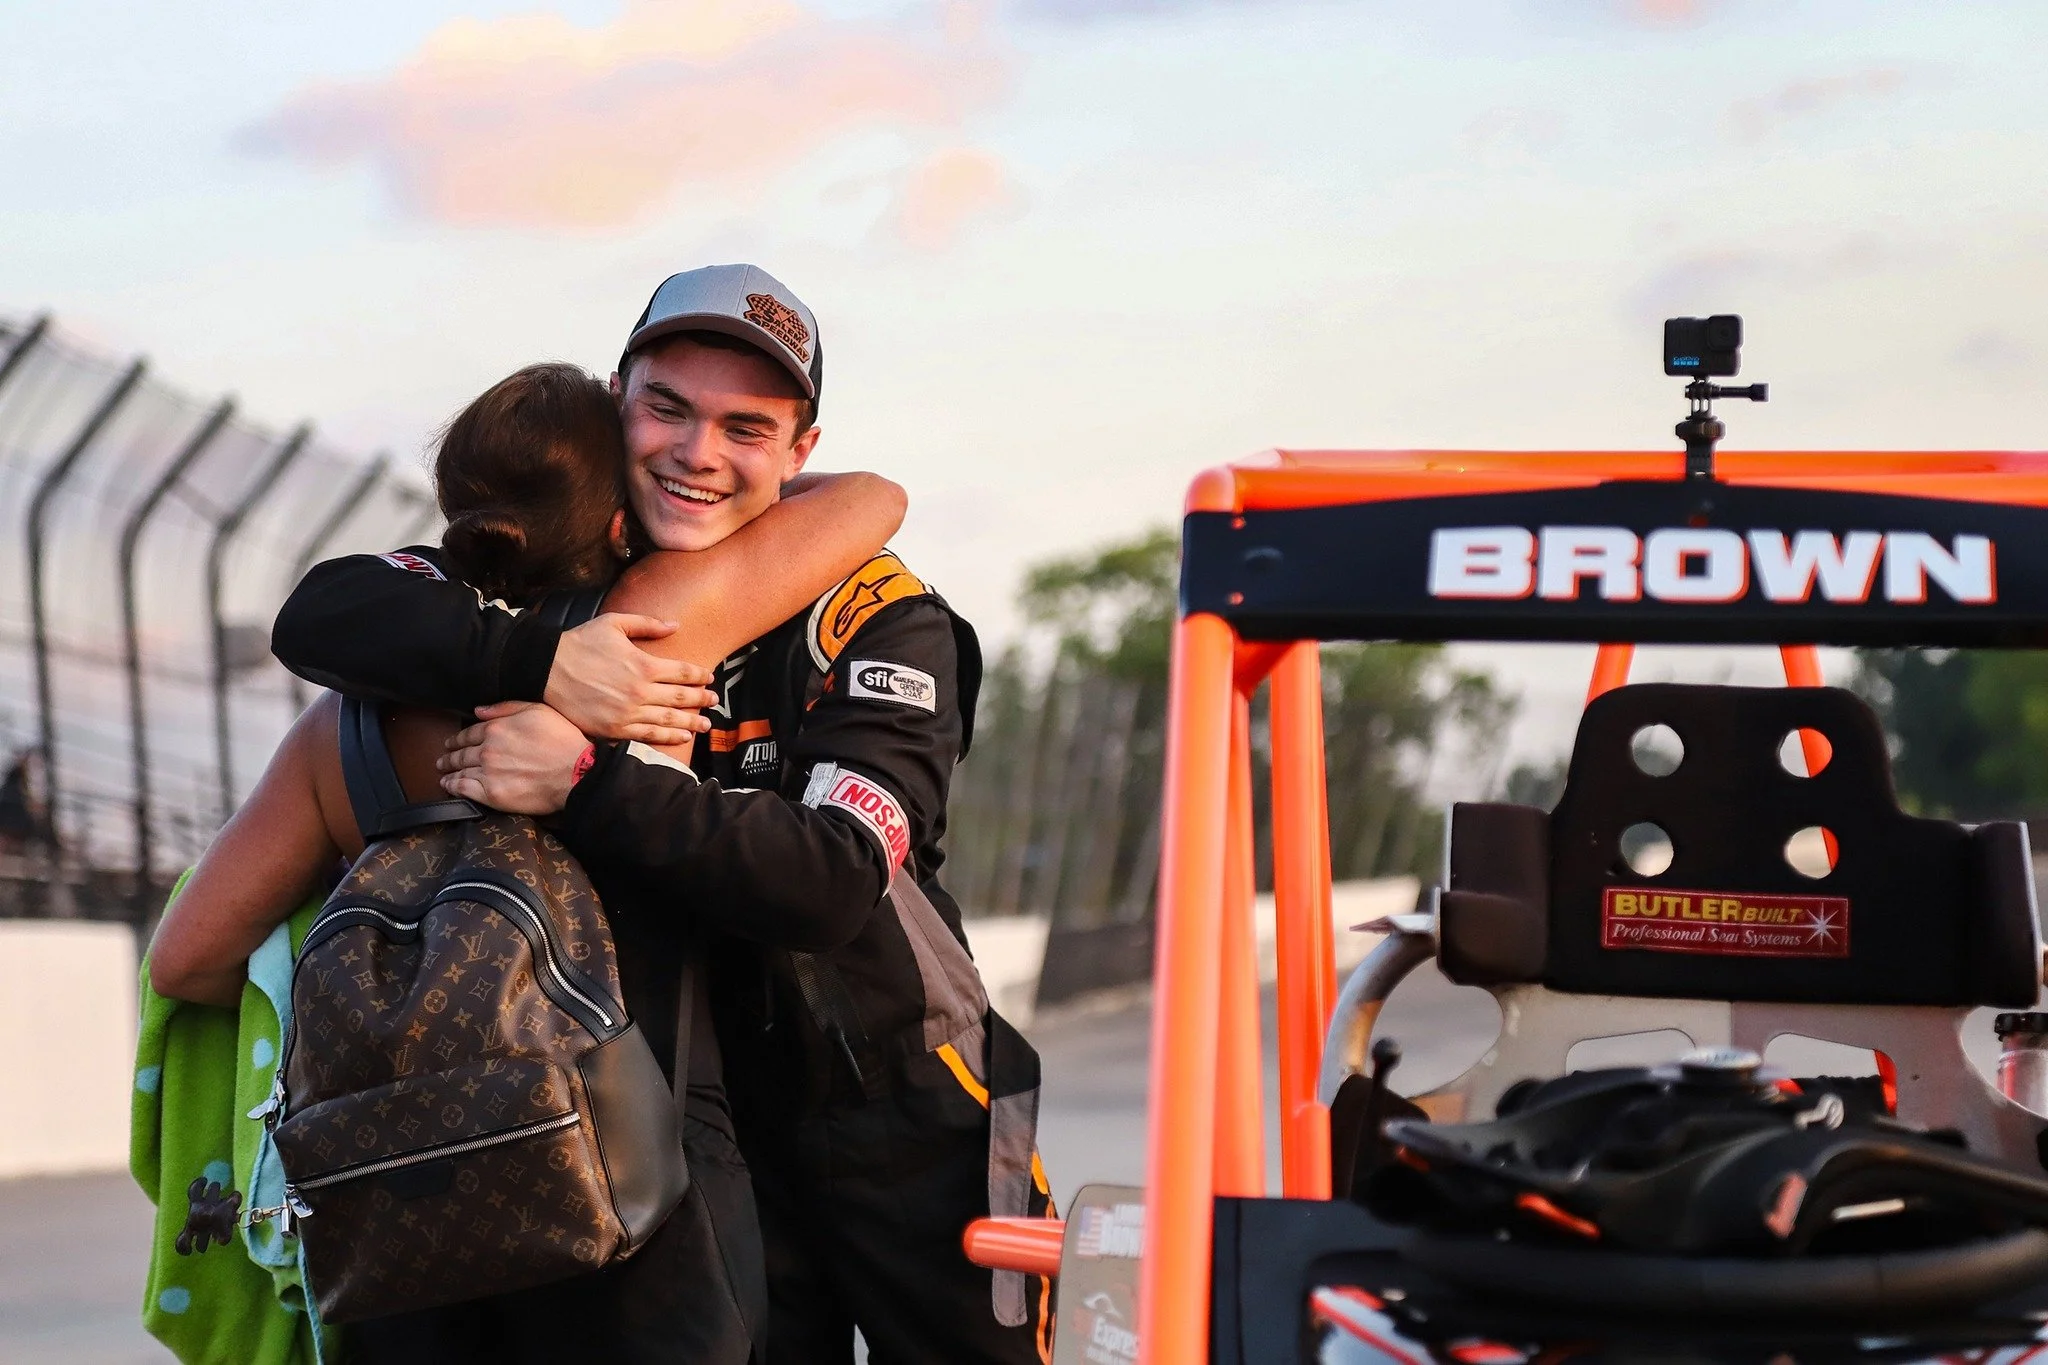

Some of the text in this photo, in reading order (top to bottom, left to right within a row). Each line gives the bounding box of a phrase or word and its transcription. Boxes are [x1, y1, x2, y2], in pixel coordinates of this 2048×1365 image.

[763, 309, 802, 343] SALEM
[776, 304, 792, 316] THE
[749, 312, 808, 359] SPEEDWAY
[1429, 526, 1997, 603] BROWN
[864, 670, 888, 688] sfi
[840, 783, 908, 868] MPSON
[1612, 923, 1802, 947] Professional Seat Systems
